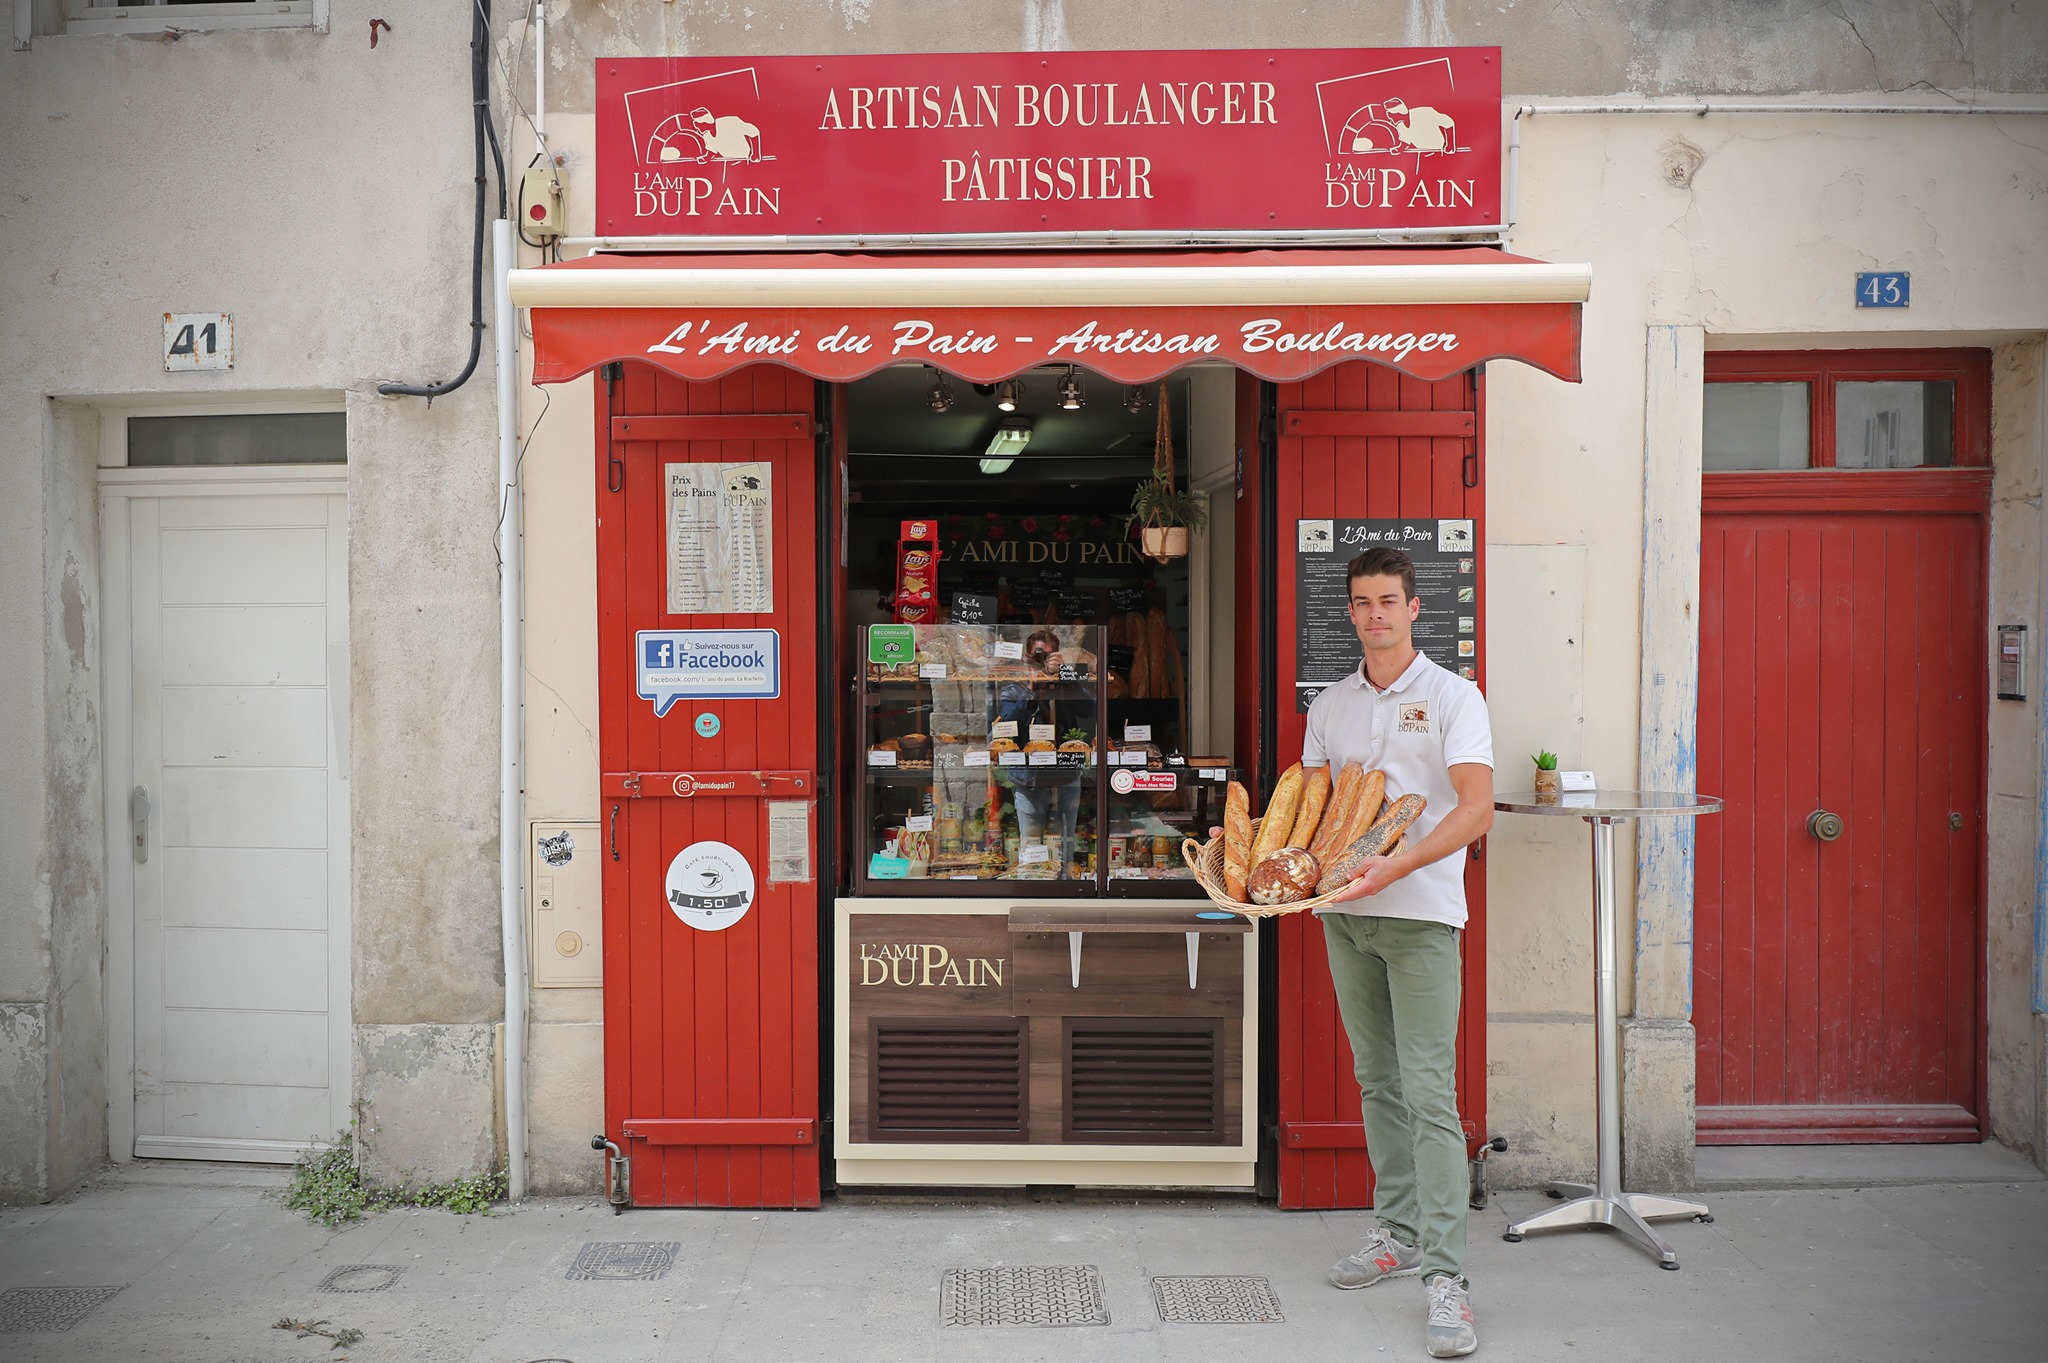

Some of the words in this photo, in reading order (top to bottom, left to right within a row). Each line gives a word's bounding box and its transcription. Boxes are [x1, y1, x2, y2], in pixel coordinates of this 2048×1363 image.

[818, 85, 1001, 131] ARTISAN
[1014, 81, 1278, 127] BOULANGER
[942, 150, 1154, 202] PÂTISSIER
[1325, 182, 1374, 208] DU
[1379, 168, 1474, 208] PAIN
[633, 191, 682, 216] DU
[686, 177, 780, 216] PAIN
[1864, 277, 1900, 303] 43
[169, 322, 217, 354] 41
[647, 320, 800, 356] L'Ami
[816, 325, 873, 355] du
[893, 319, 999, 356] Pain
[1047, 320, 1221, 357] Artisan
[1240, 318, 1460, 363] Boulanger
[672, 475, 691, 485] Prix
[672, 487, 689, 498] des
[692, 487, 717, 498] Pains
[739, 494, 767, 506] PAIN
[1340, 525, 1381, 544] L'Ami
[1384, 528, 1400, 541] du
[1402, 526, 1433, 543] Pain
[1028, 541, 1071, 565] DU
[1079, 541, 1145, 564] PAIN
[695, 642, 740, 650] Suivez-nous
[679, 650, 765, 669] Facebook
[650, 675, 701, 684] facebook.com/
[692, 782, 735, 790] @lamidupain17
[860, 958, 918, 986] DU
[919, 944, 1006, 986] PAIN
